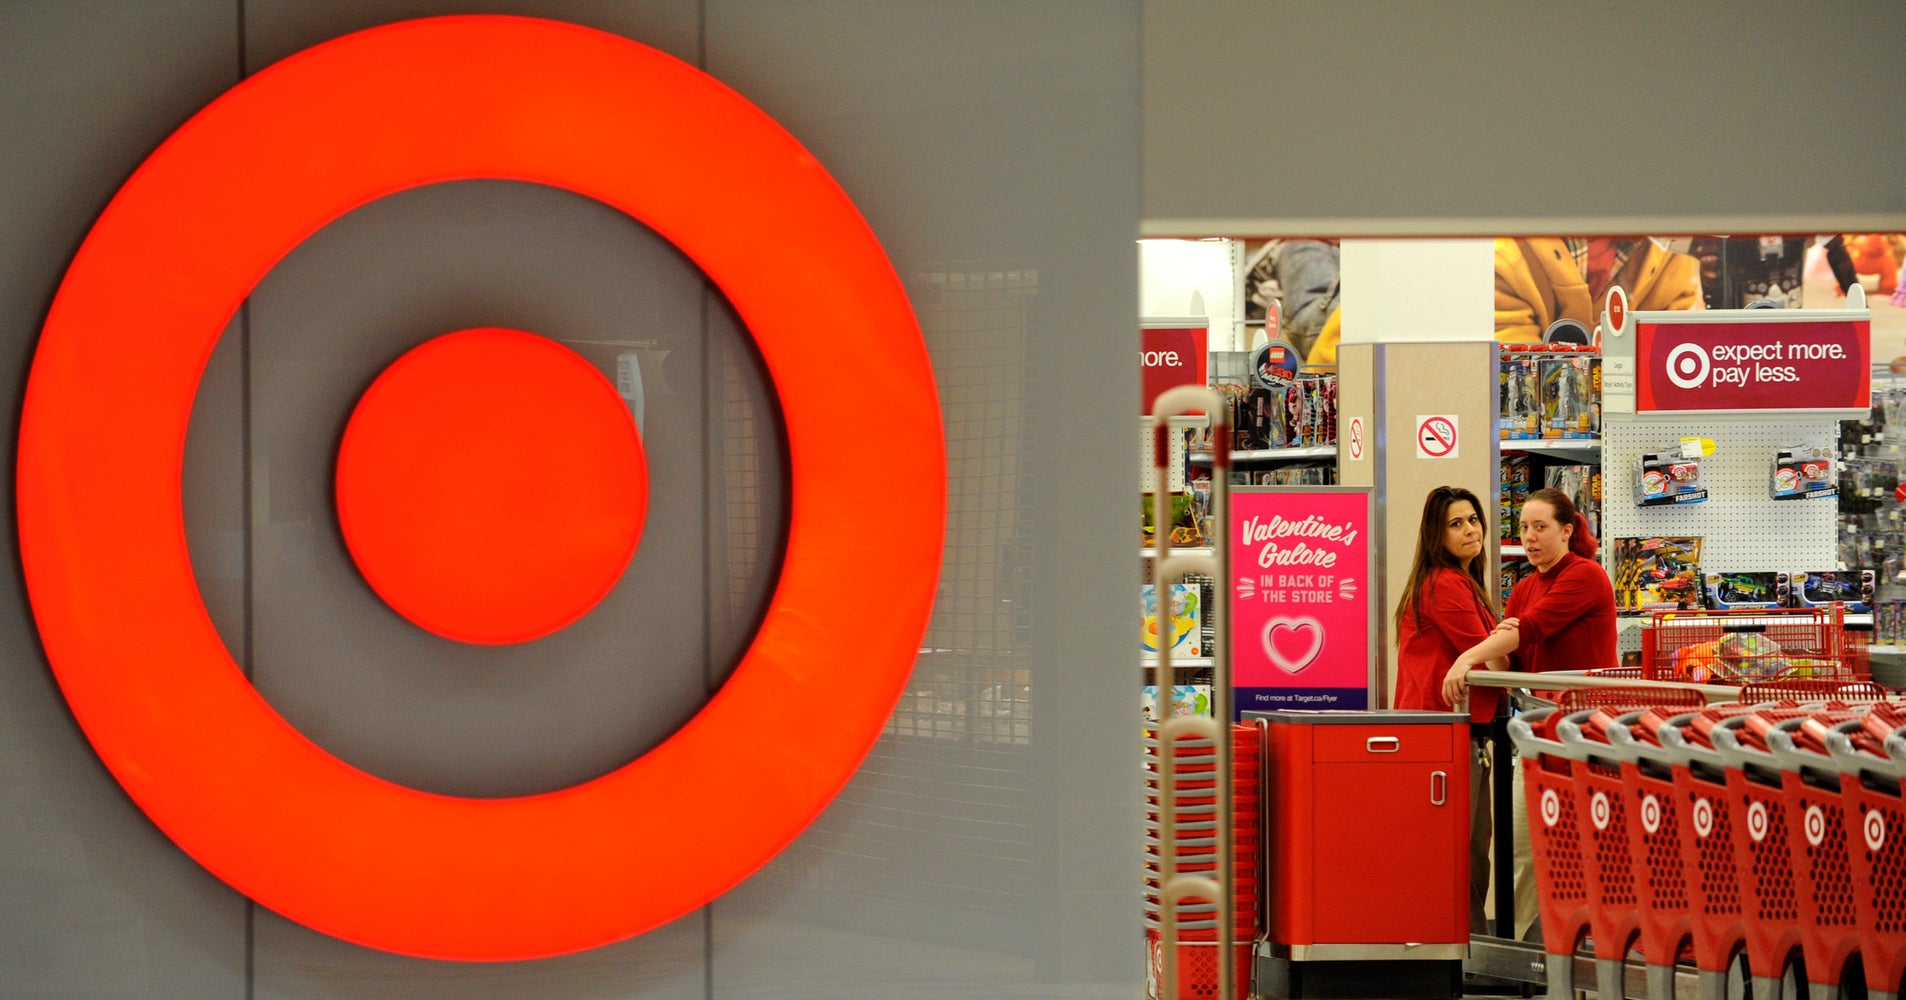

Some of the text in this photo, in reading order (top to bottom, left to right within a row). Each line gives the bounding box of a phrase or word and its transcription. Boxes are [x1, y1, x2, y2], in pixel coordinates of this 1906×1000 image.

[1712, 341, 1847, 365] expect more.
[1713, 362, 1801, 388] pay less.
[1243, 514, 1357, 546] Valentine's
[1258, 541, 1337, 569] Galore
[1260, 575, 1334, 588] IN BACK OF
[1262, 590, 1333, 603] THE STORE
[1255, 694, 1269, 702] Find
